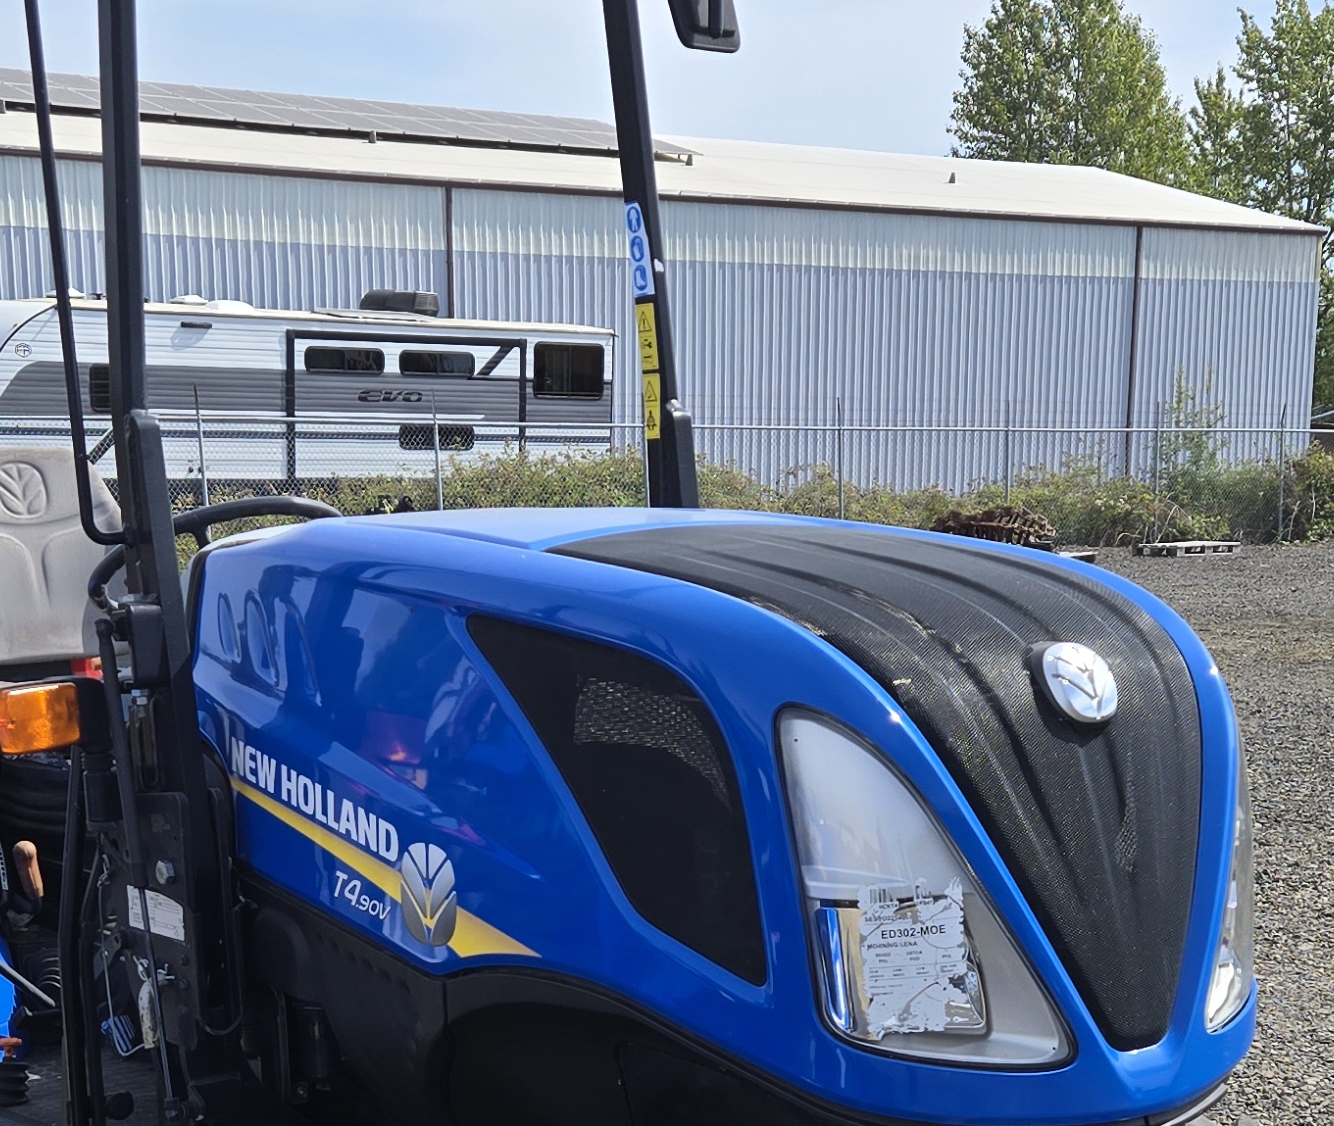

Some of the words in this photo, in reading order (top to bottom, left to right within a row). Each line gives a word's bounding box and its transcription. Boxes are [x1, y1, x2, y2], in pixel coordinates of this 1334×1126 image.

[357, 390, 424, 403] EVO
[231, 736, 276, 794] NEW
[281, 764, 399, 862] HOLLAND
[334, 870, 391, 920] T4.90V
[881, 924, 946, 940] ED302-MOE
